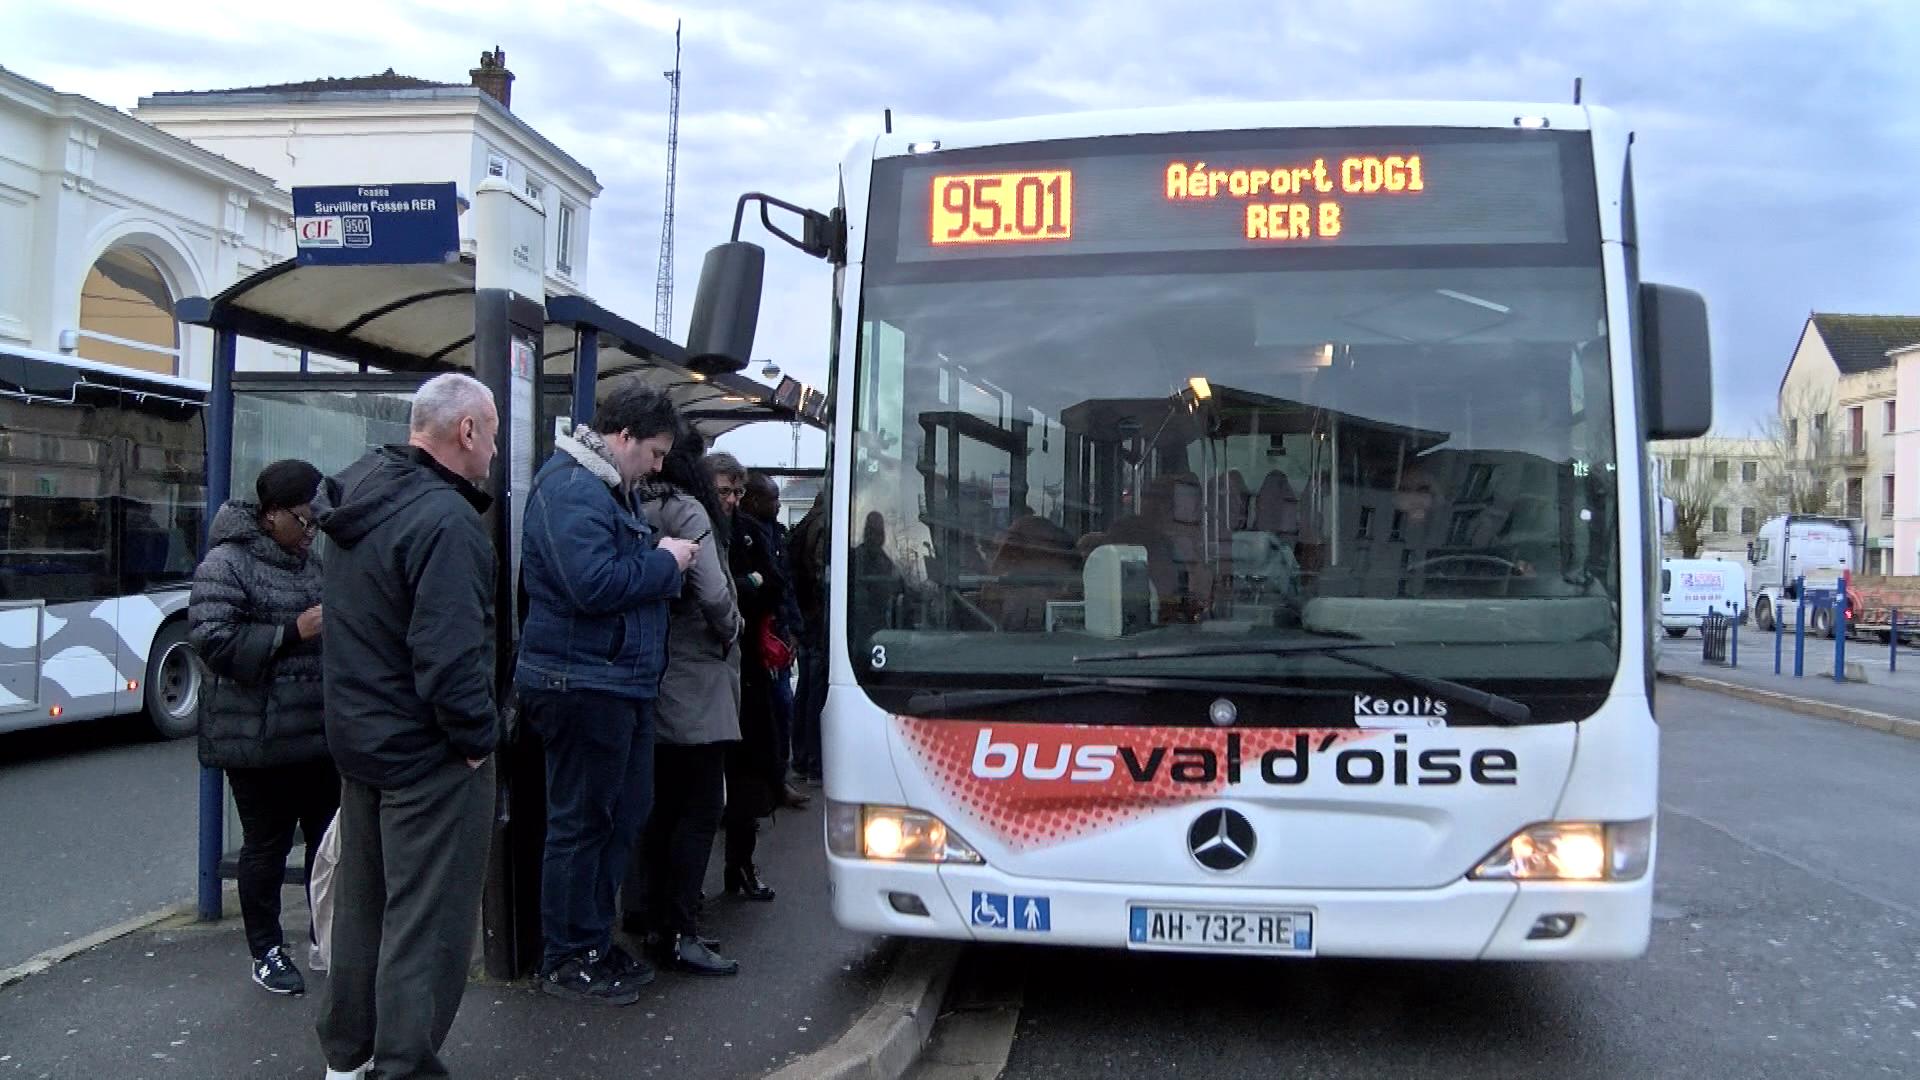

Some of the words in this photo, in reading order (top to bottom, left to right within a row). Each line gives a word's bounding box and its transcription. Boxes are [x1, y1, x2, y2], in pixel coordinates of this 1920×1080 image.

[1167, 158, 1333, 199] Aéroport
[1341, 156, 1424, 193] CDG1
[370, 200, 410, 213] Fosses
[411, 199, 436, 211] RER
[942, 175, 1067, 238] 95.01
[302, 219, 333, 240] CIF
[345, 219, 369, 233] 9501
[1246, 203, 1311, 239] RER
[1318, 202, 1342, 237] B
[871, 644, 887, 669] 3
[1354, 695, 1448, 717] Keolis
